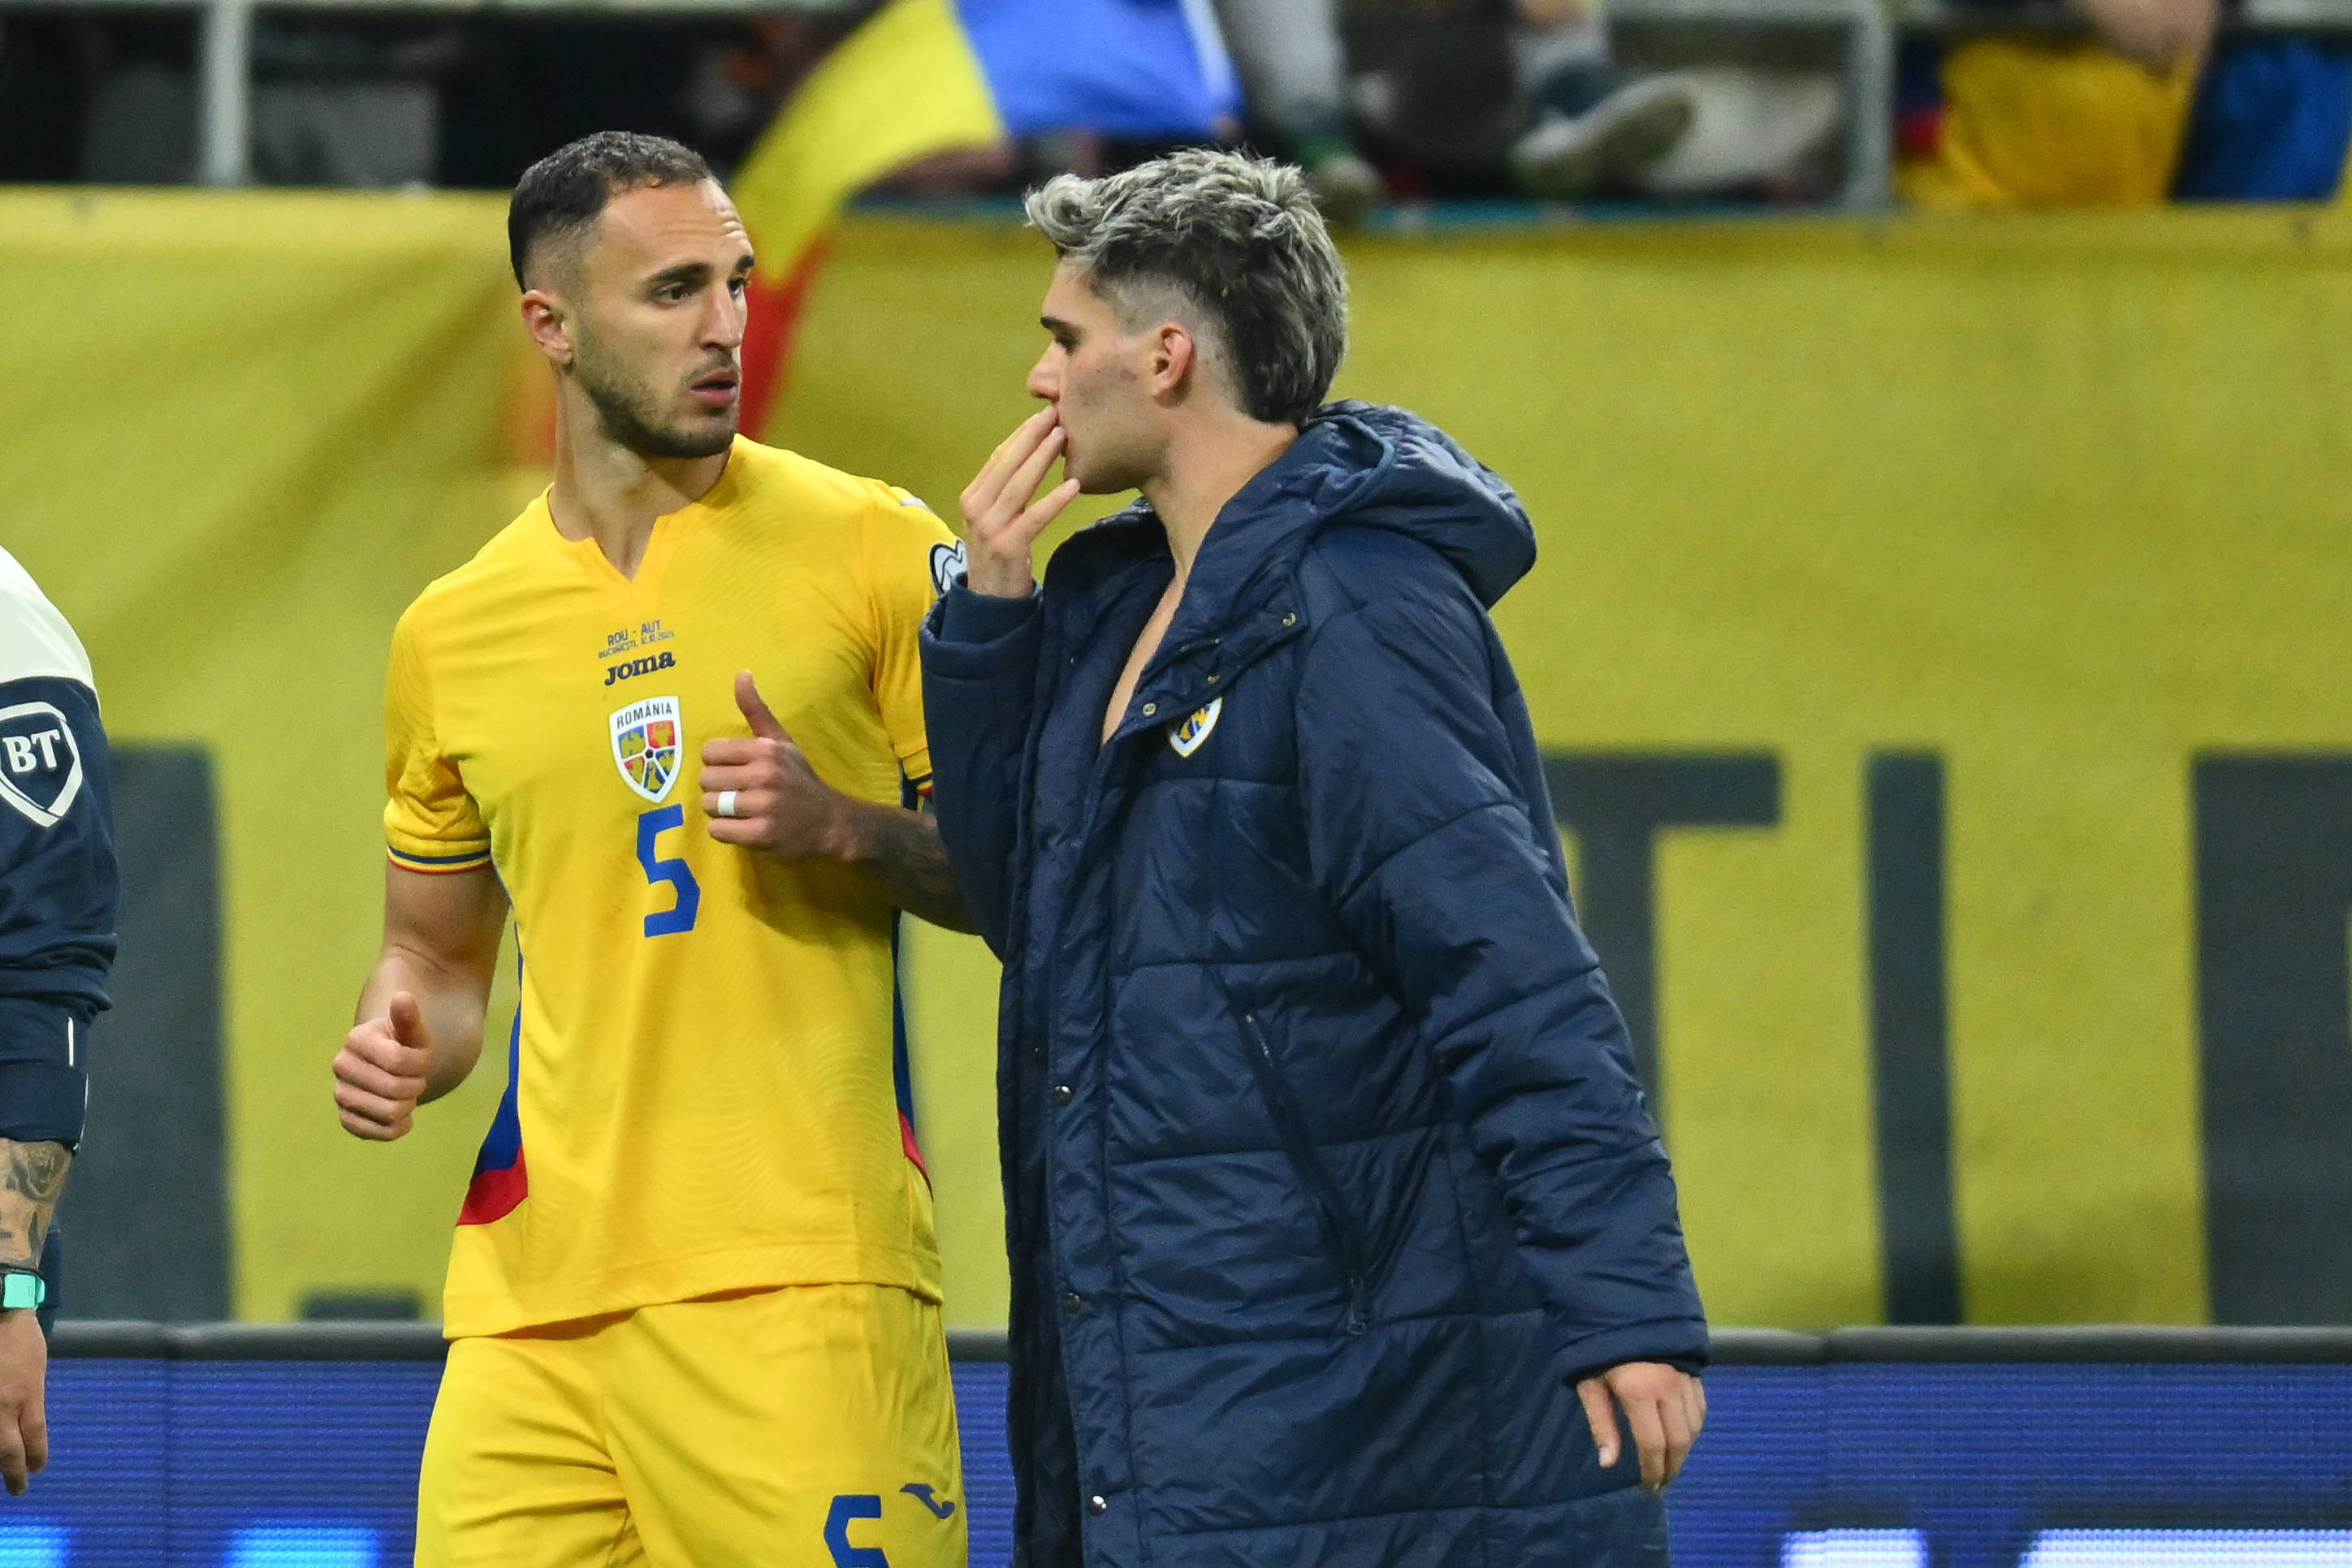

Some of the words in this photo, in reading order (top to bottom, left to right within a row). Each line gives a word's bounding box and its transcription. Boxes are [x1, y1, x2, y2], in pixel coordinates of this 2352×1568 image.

[616, 701, 672, 730] ROMÂNIA
[2, 728, 61, 773] BT
[636, 803, 701, 938] 5
